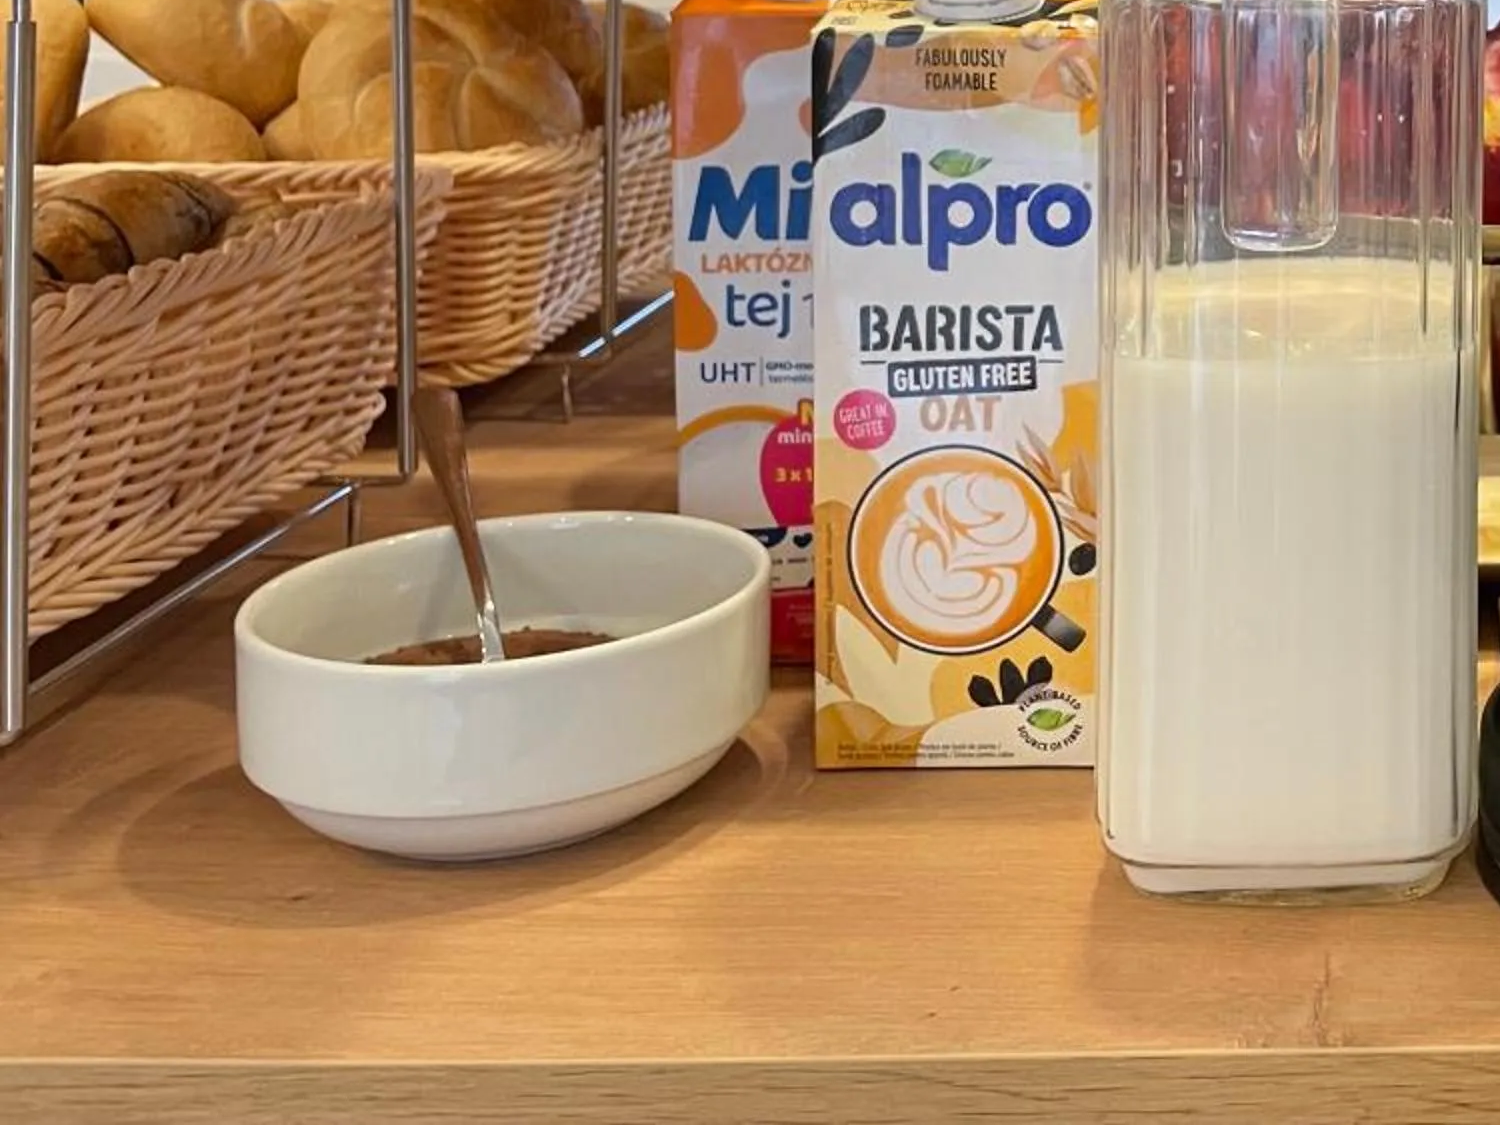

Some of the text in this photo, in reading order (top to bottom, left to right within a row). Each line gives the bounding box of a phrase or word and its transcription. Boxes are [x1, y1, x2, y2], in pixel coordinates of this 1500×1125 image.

[915, 48, 1006, 68] FABULOUSLY
[925, 72, 998, 91] FOAMABLE
[829, 152, 1092, 271] alpro
[725, 279, 791, 339] tej
[859, 304, 1064, 352] BARISTA
[700, 362, 756, 383] UHT
[893, 361, 1032, 392] GLUTEN FREE
[919, 395, 1003, 432] OAT
[846, 420, 885, 440] COFFEE
